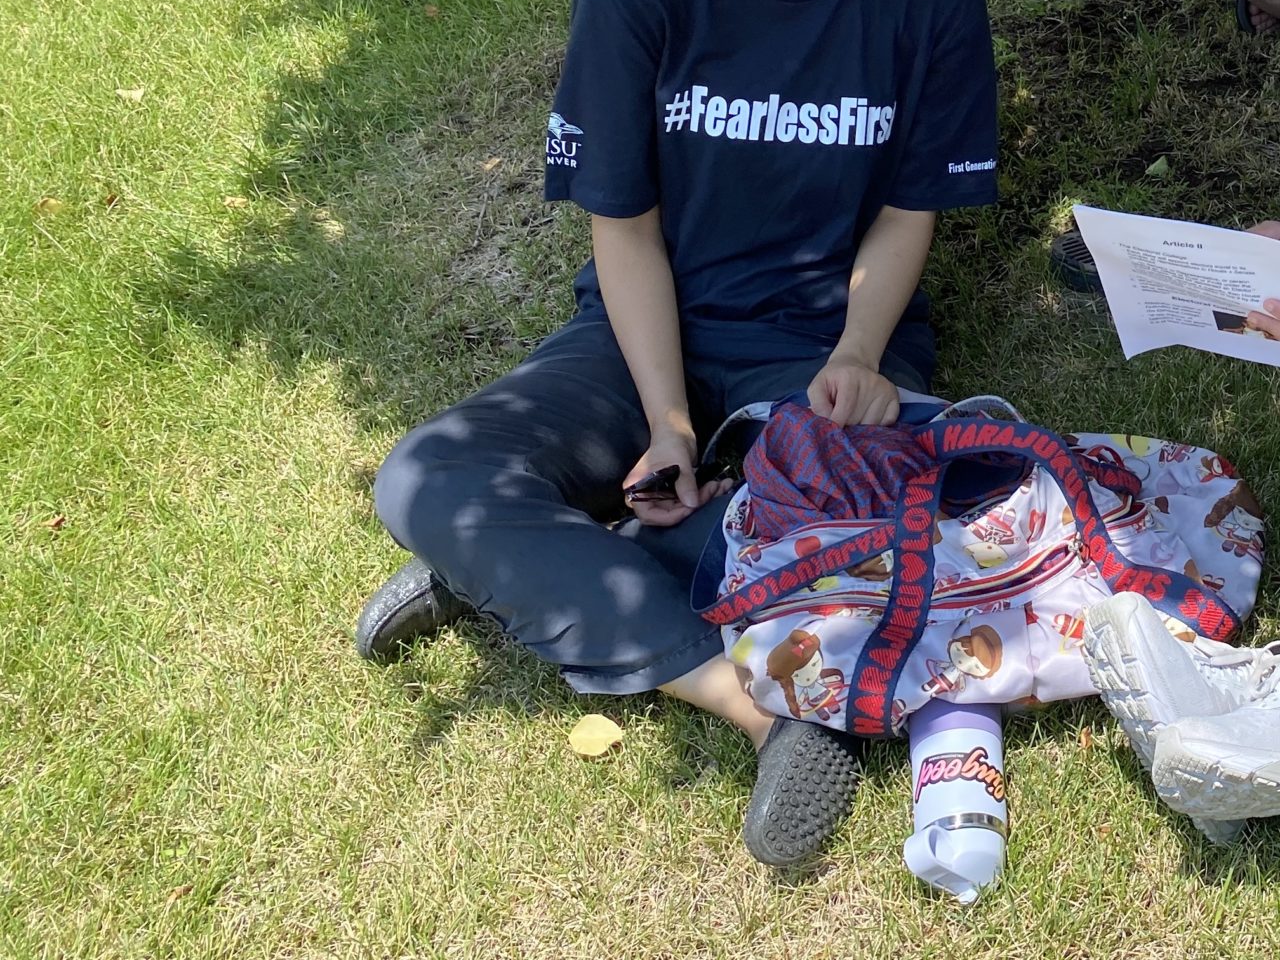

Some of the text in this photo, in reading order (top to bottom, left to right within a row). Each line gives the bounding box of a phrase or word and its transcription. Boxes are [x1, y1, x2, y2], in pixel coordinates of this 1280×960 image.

[664, 84, 897, 146] #FearlessFirs
[546, 156, 577, 168] NVER
[948, 162, 964, 174] First
[1162, 240, 1194, 249] Article
[943, 424, 1084, 498] HARAJUKU
[1082, 516, 1172, 601] LOVERS
[853, 583, 926, 735] HARAJUKU
